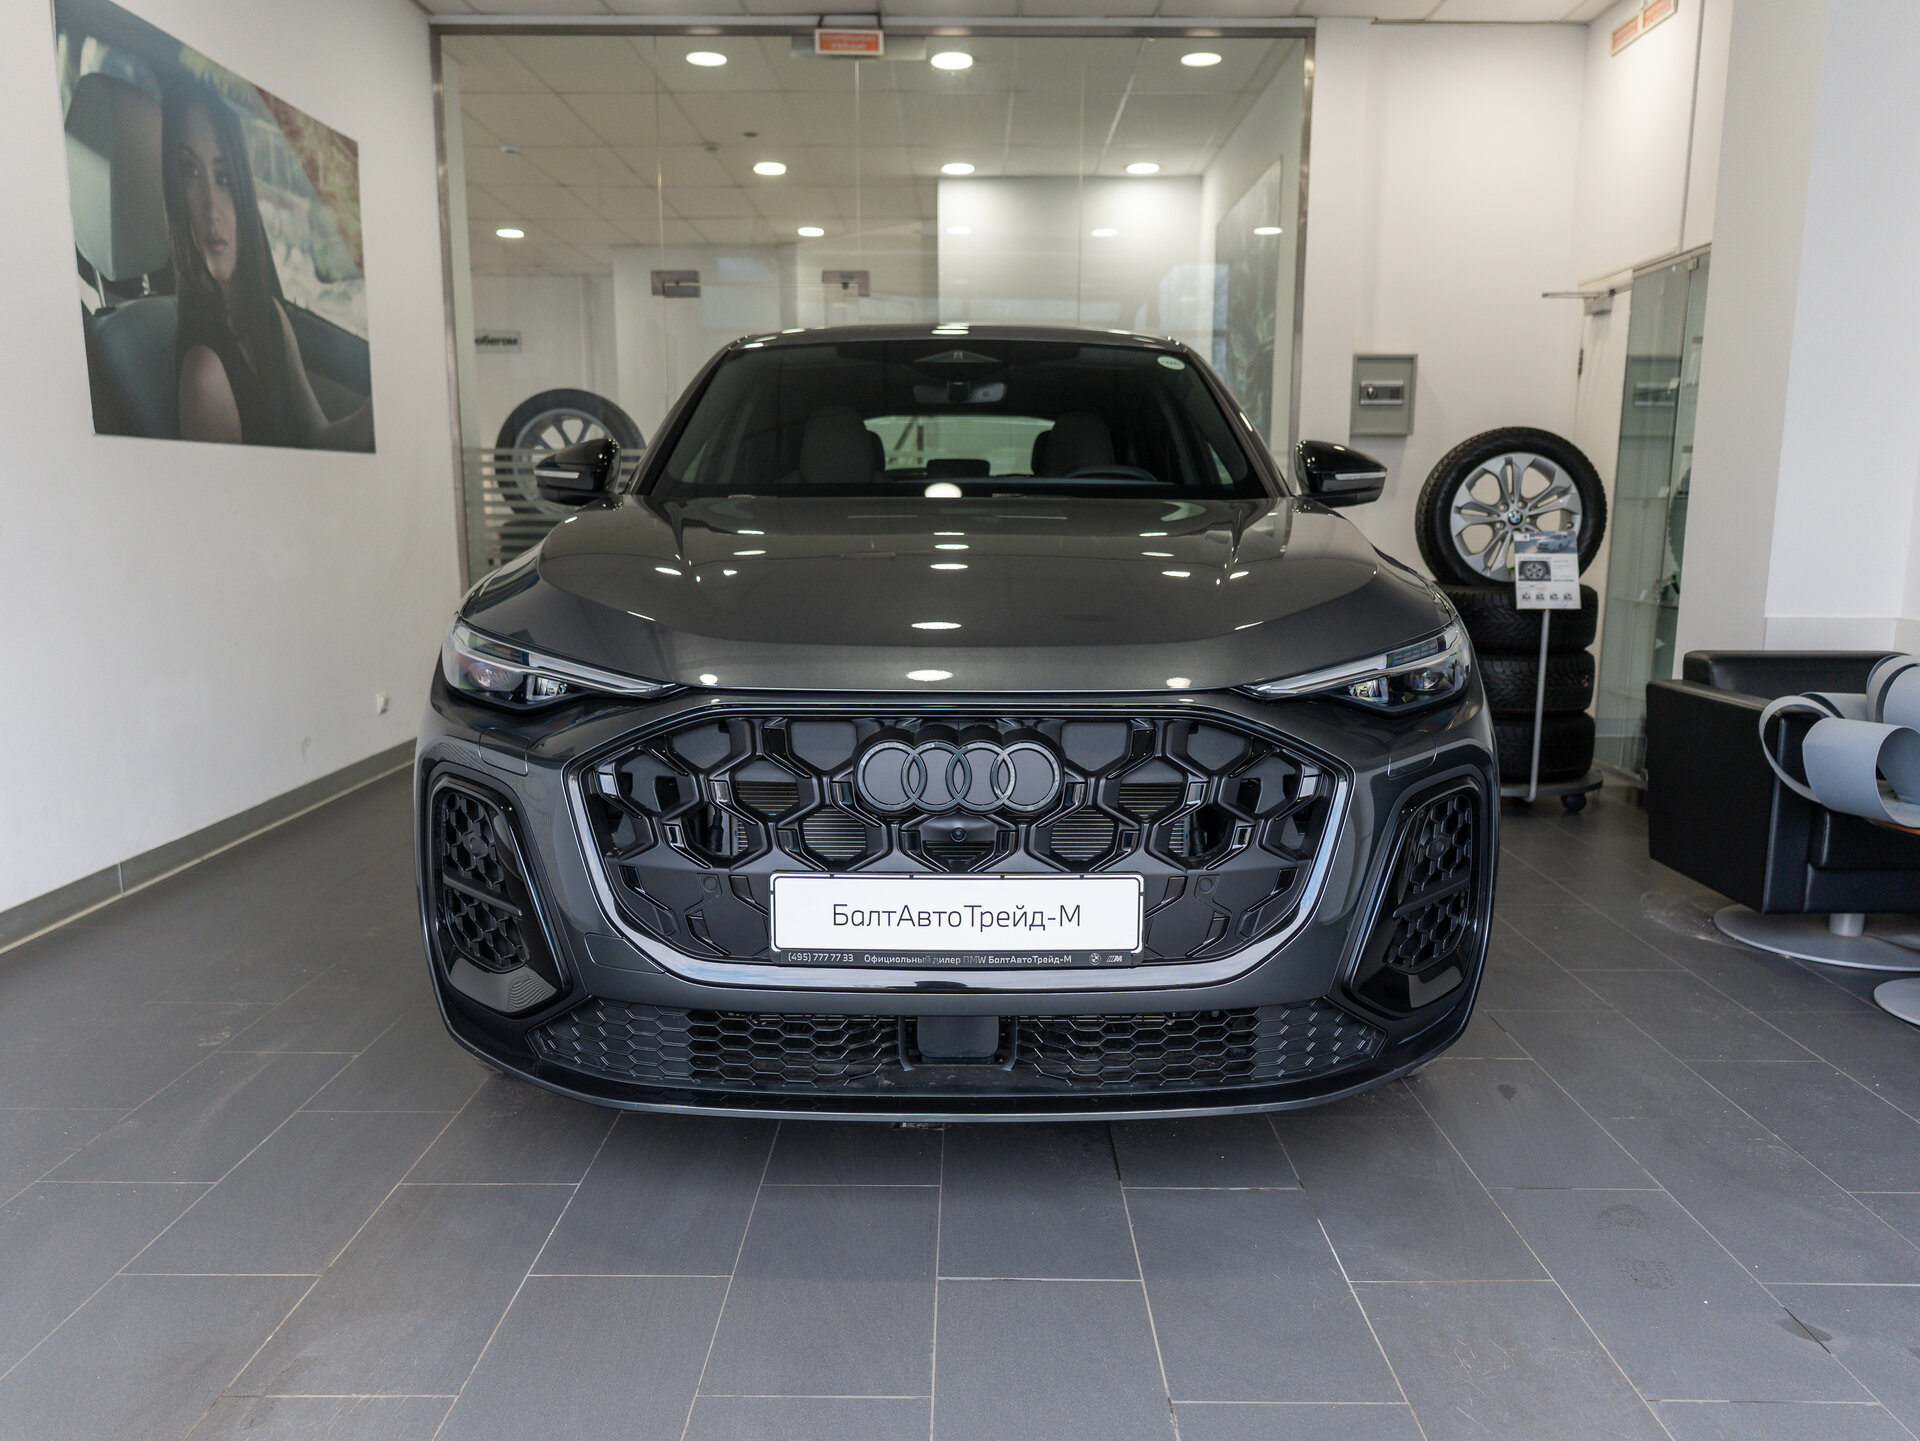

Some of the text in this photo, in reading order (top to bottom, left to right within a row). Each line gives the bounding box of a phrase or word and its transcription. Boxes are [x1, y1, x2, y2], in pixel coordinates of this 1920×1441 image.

[833, 903, 1081, 932] БалтАвтоТрейд-М
[788, 952, 854, 963] (495) 777 77 33
[863, 954, 931, 965] Официальный
[932, 957, 961, 965] дилер
[988, 955, 1072, 965] БалтАвтоТрейд-М
